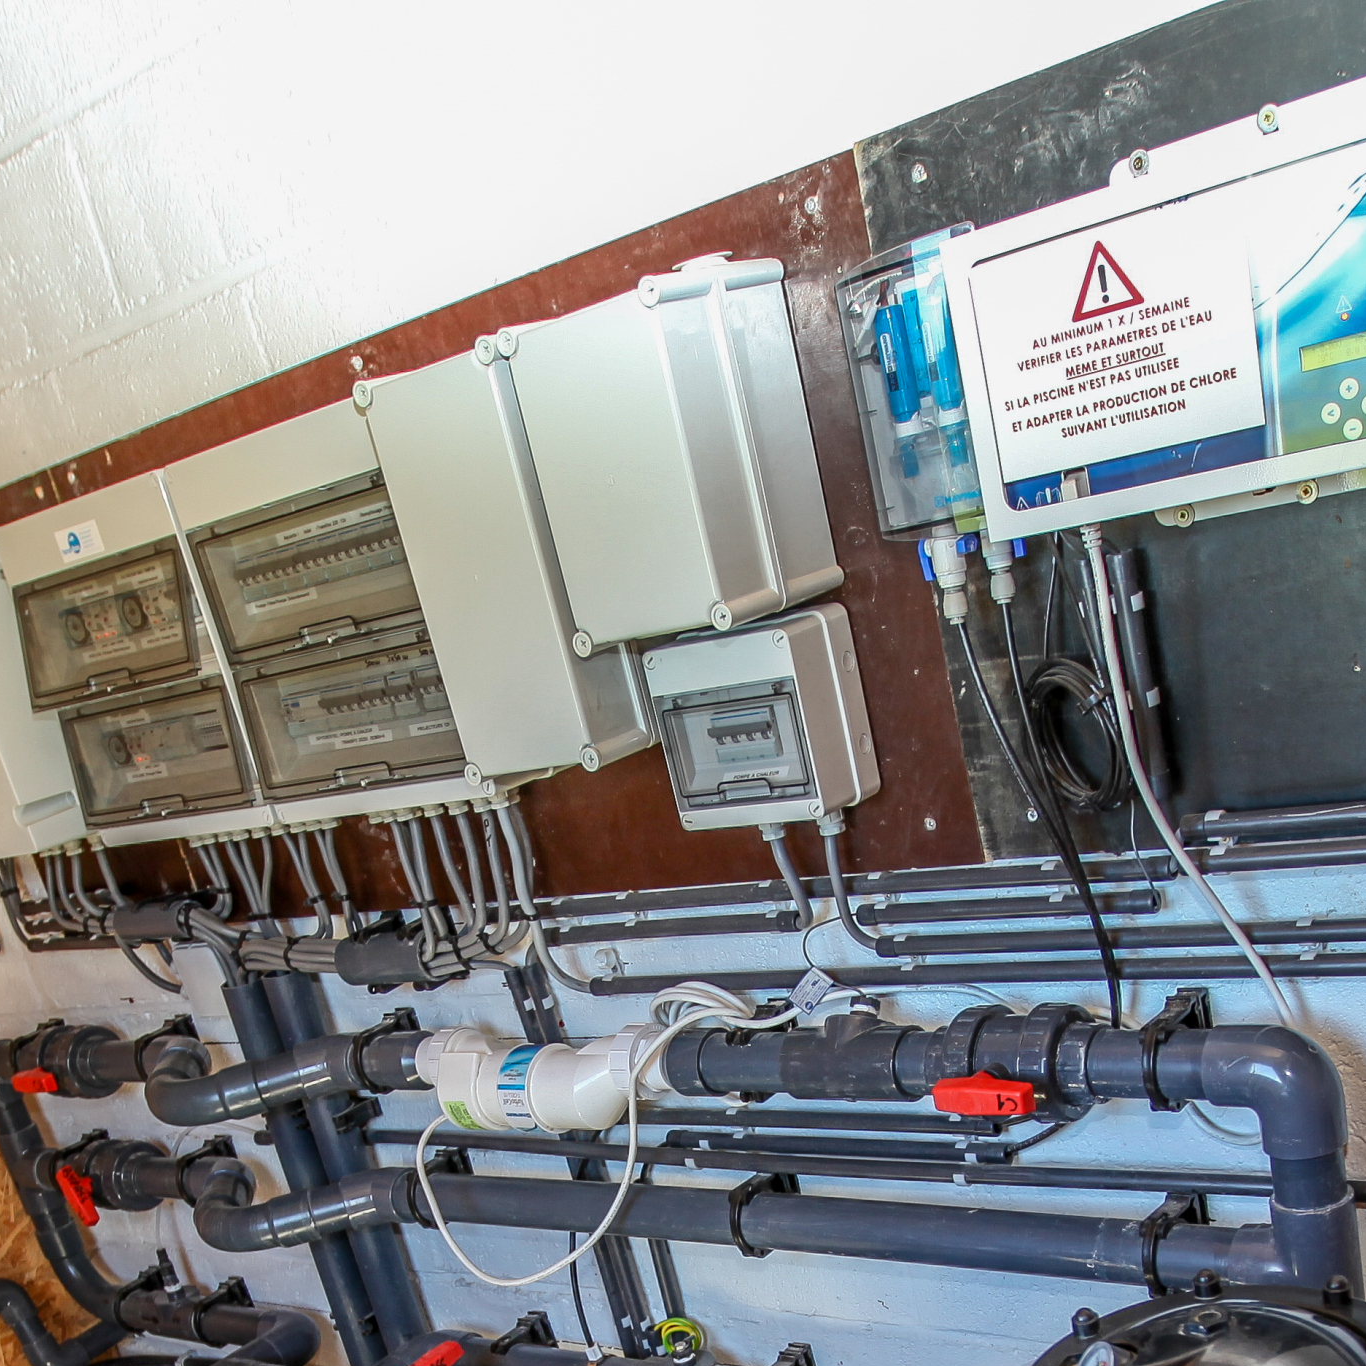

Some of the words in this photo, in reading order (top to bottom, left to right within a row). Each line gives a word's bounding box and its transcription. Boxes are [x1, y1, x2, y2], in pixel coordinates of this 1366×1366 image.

[1017, 350, 1062, 372] VERIFIER
[1065, 346, 1083, 360] LES
[1086, 325, 1158, 353] PARAMETRES
[1162, 320, 1176, 333] DE
[1180, 310, 1213, 329] L'EAU
[1033, 337, 1047, 350] AU
[1051, 321, 1104, 345] MINIMUM
[1108, 318, 1113, 330] 1
[1118, 315, 1126, 327] X
[1138, 296, 1190, 321] SEMAINE
[1005, 400, 1014, 412] SI
[1017, 396, 1030, 409] LA
[1033, 383, 1075, 405] PISCINE
[1078, 376, 1106, 393] N'EST
[1110, 370, 1131, 385] PAS
[1135, 357, 1180, 379] UTILISEE
[1065, 360, 1098, 378] MEME
[1101, 356, 1112, 368] ET
[1115, 342, 1165, 365] SURTOUT
[1012, 420, 1022, 433] ET
[1026, 409, 1073, 430] ADAPTER
[1076, 404, 1090, 417] LA
[1093, 384, 1167, 413] PRODUCTION
[1171, 380, 1186, 394] DE
[1189, 367, 1237, 389] CHLORE
[1061, 418, 1108, 439] SUIVANT
[1111, 398, 1187, 427] L'UTILISATION
